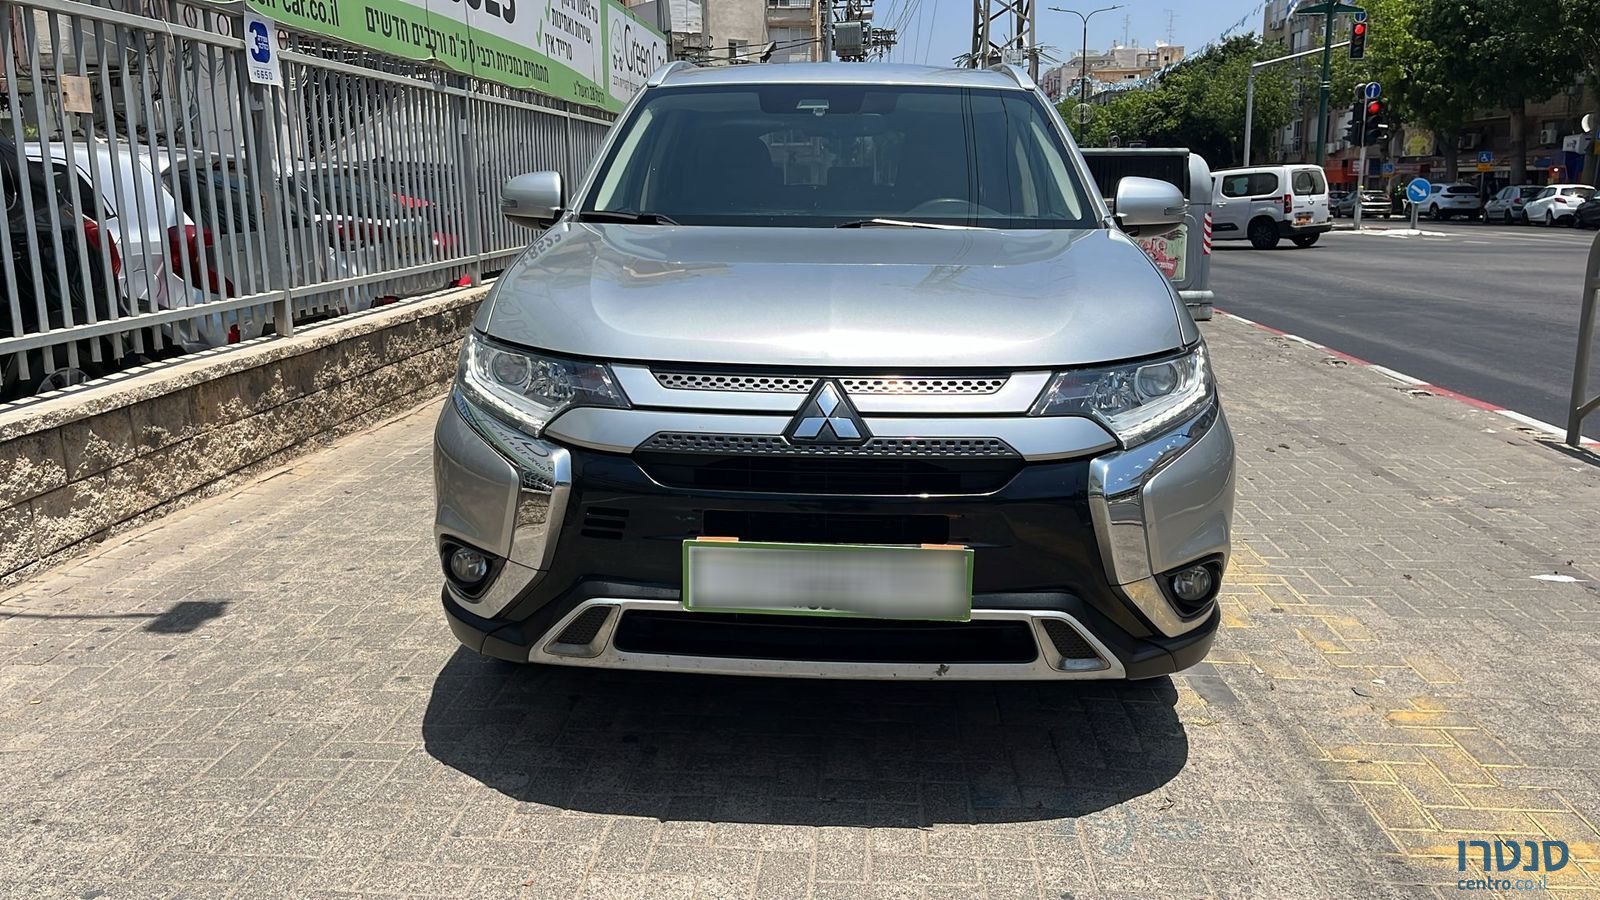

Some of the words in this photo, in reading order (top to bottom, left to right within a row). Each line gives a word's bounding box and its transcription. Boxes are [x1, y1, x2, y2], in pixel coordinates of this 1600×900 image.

[251, 0, 340, 27] car.co.il
[365, 6, 410, 43] חדשים
[411, 22, 447, 55] ורכבים
[544, 33, 555, 57] אין
[624, 24, 651, 79] Green
[476, 46, 495, 69] רכבי
[496, 52, 523, 76] במכירת
